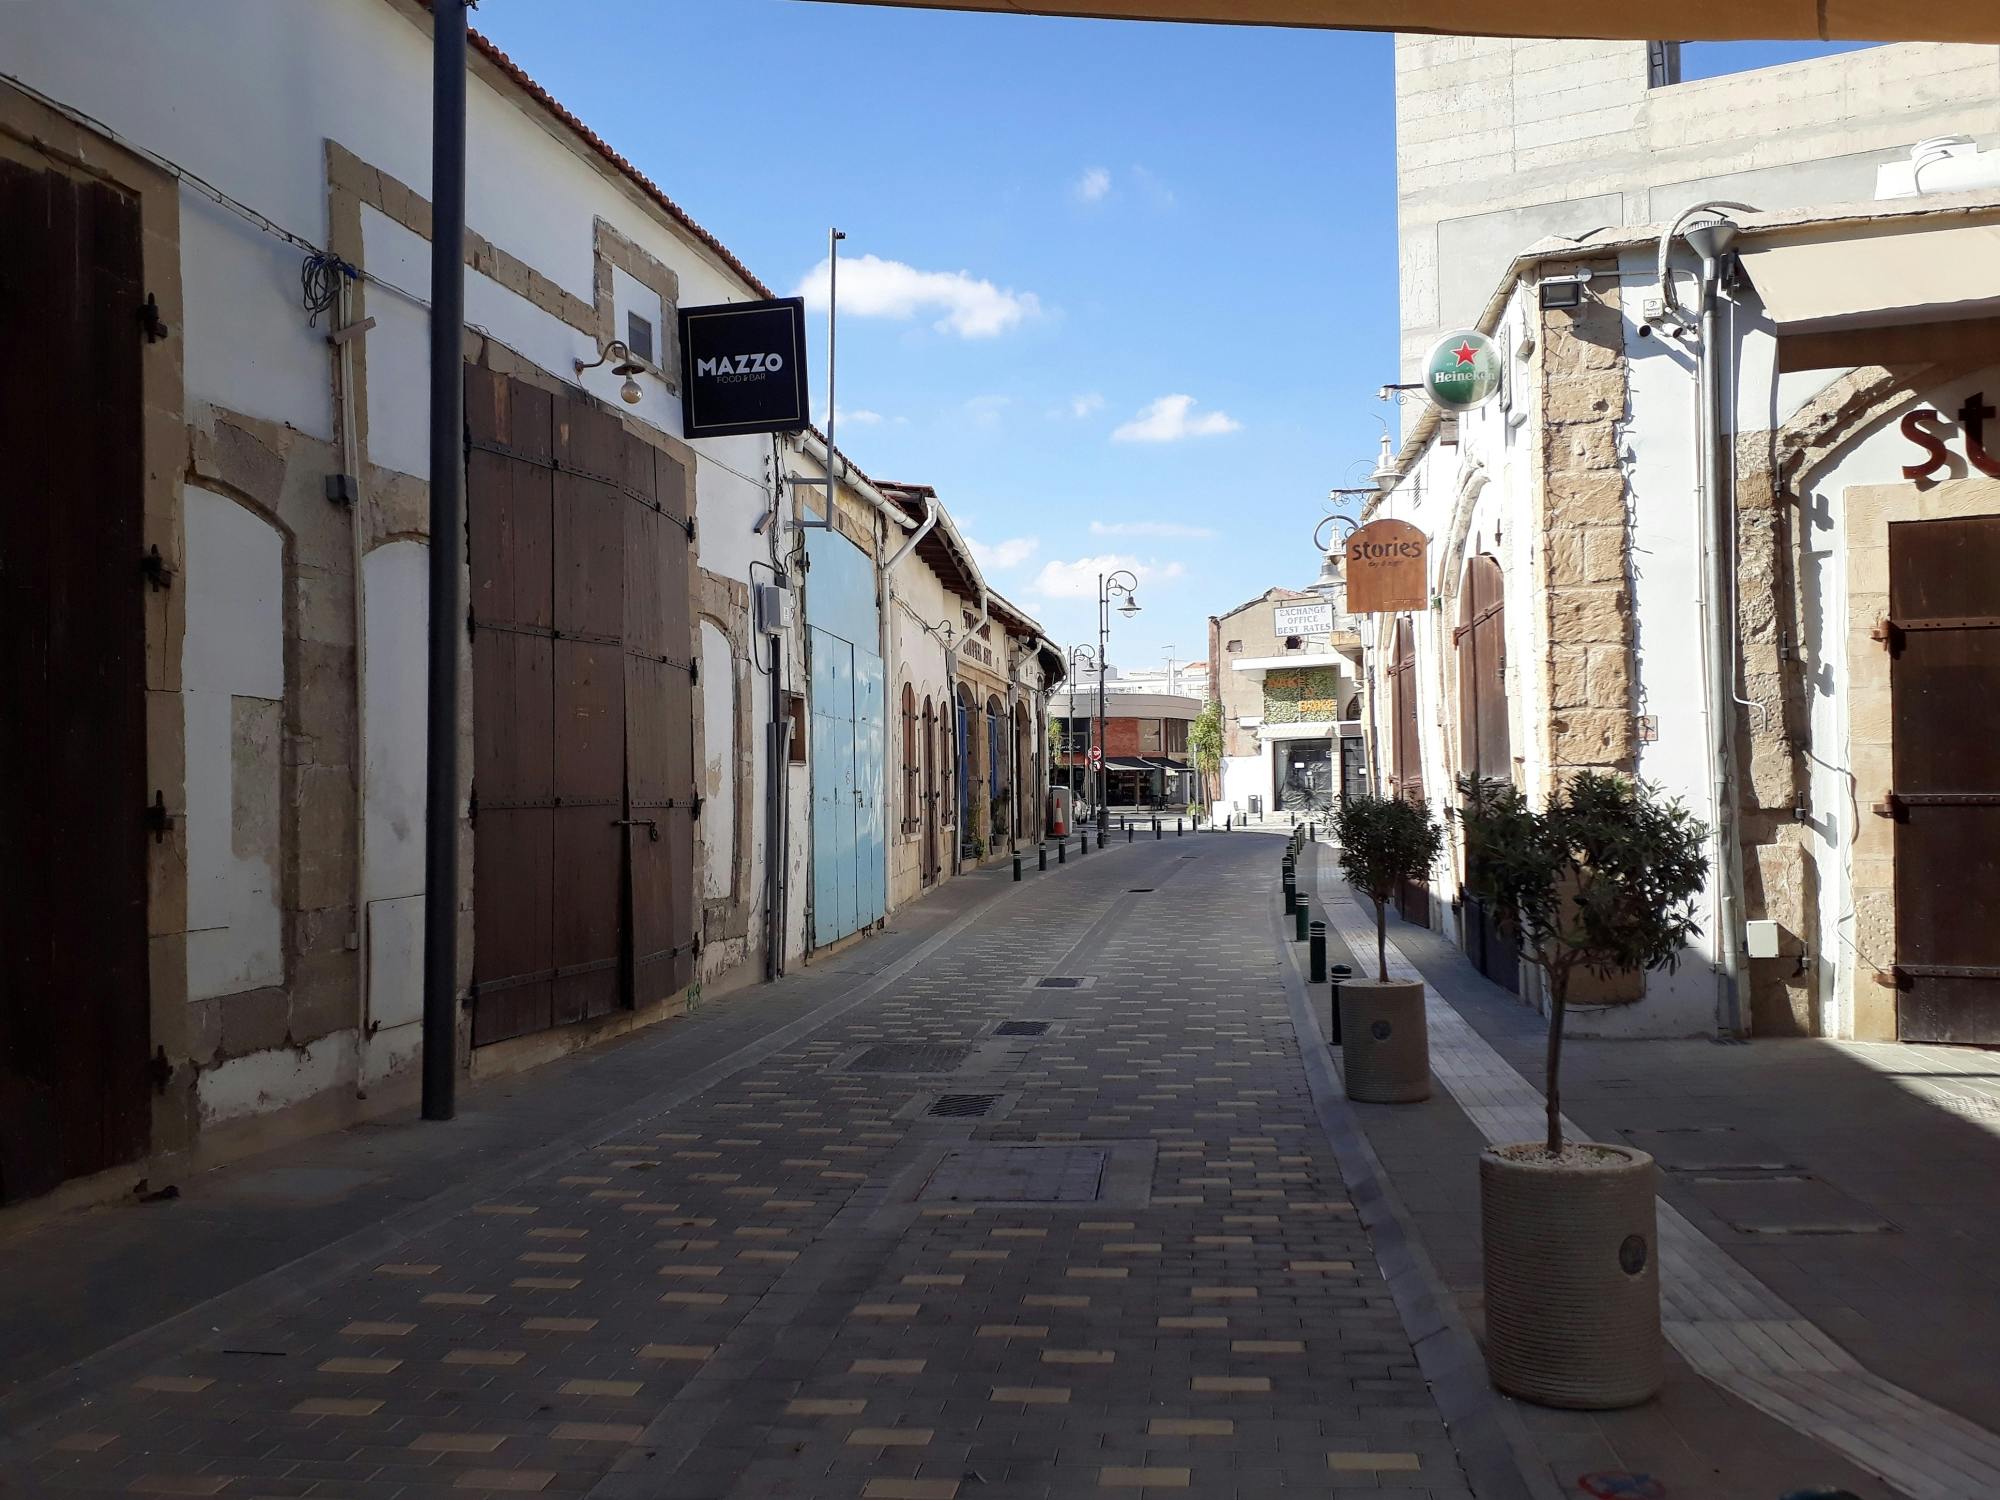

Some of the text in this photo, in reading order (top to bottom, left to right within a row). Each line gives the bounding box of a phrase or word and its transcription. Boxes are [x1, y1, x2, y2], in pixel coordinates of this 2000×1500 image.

[697, 353, 783, 377] MAZZO
[716, 375, 742, 384] FOOD
[749, 373, 766, 381] BAR
[1434, 371, 1495, 383] Heineken
[1352, 536, 1422, 561] stories
[1279, 605, 1327, 617] EXCHANGE
[1287, 614, 1319, 625] OFFICE
[1277, 622, 1331, 635] BEST RATES
